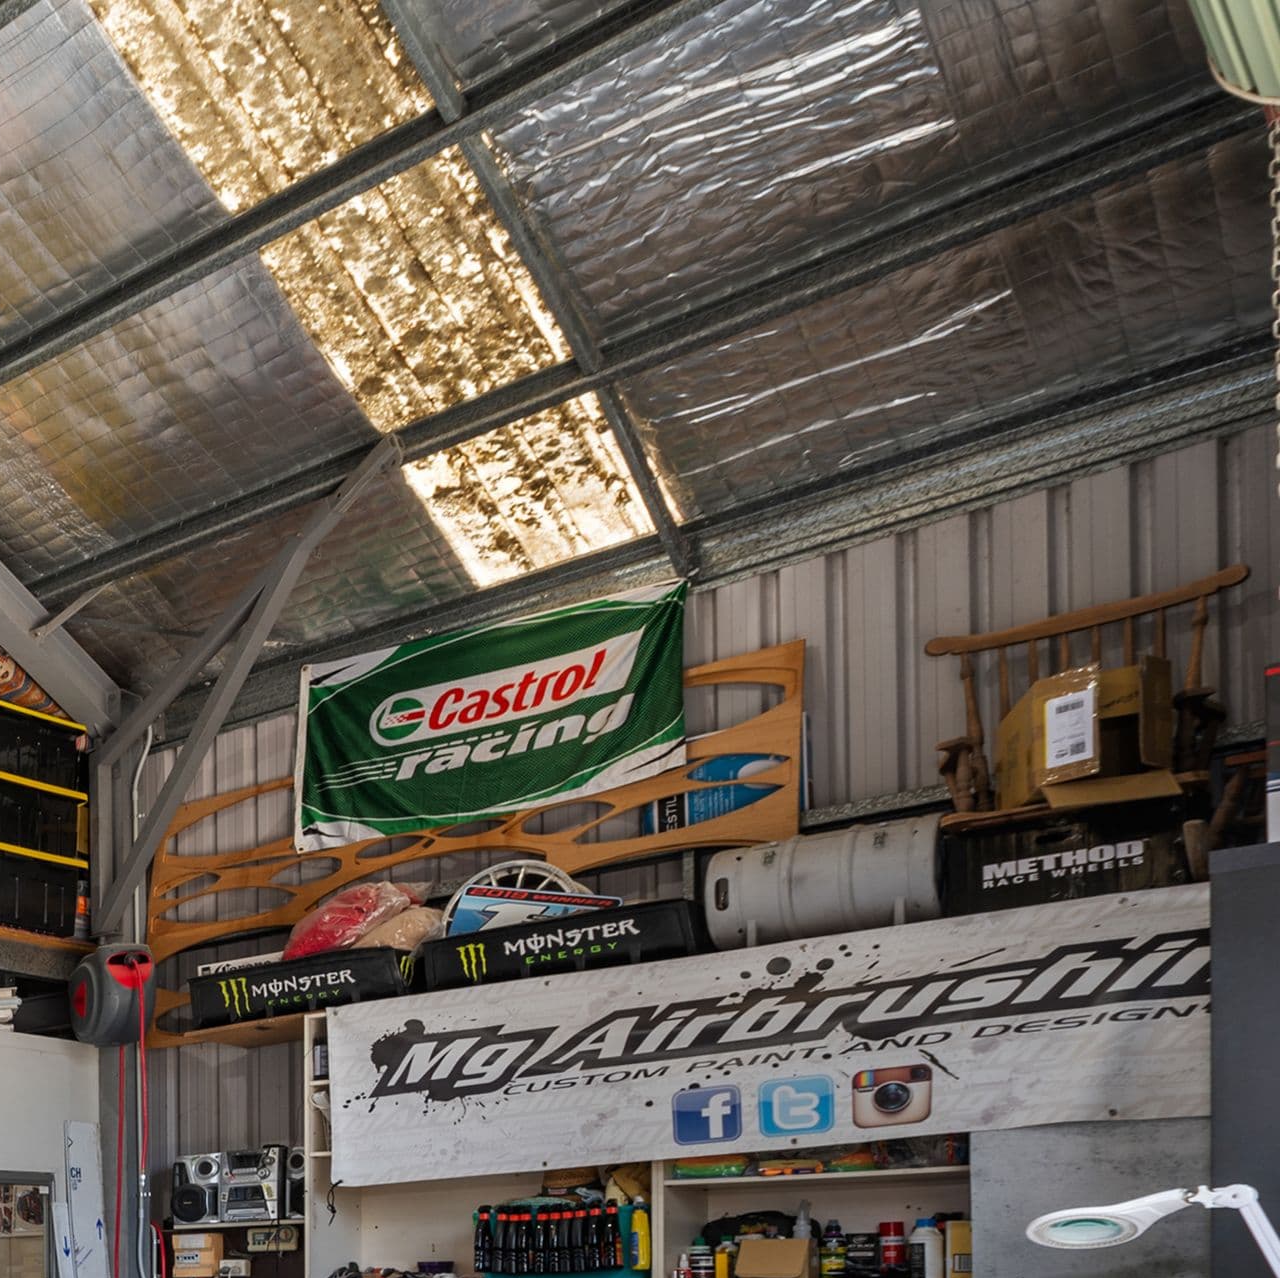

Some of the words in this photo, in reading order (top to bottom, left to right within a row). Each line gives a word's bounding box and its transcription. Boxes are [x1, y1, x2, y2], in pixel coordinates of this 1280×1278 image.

[428, 649, 607, 731] Castrol
[395, 693, 635, 781] racing
[982, 840, 1145, 881] METHOD
[982, 872, 1040, 889] RACE
[1051, 855, 1145, 878] WHEELS
[537, 892, 614, 906] WINNER
[503, 918, 640, 957] MONSTER
[525, 942, 619, 965] ENERGY
[251, 969, 357, 999] MONSTER
[266, 989, 342, 1006] ENERGY
[387, 1039, 532, 1088] Mg
[502, 1066, 668, 1096] CUSTOM
[685, 1046, 829, 1074] PAINT
[839, 1032, 952, 1051] AND
